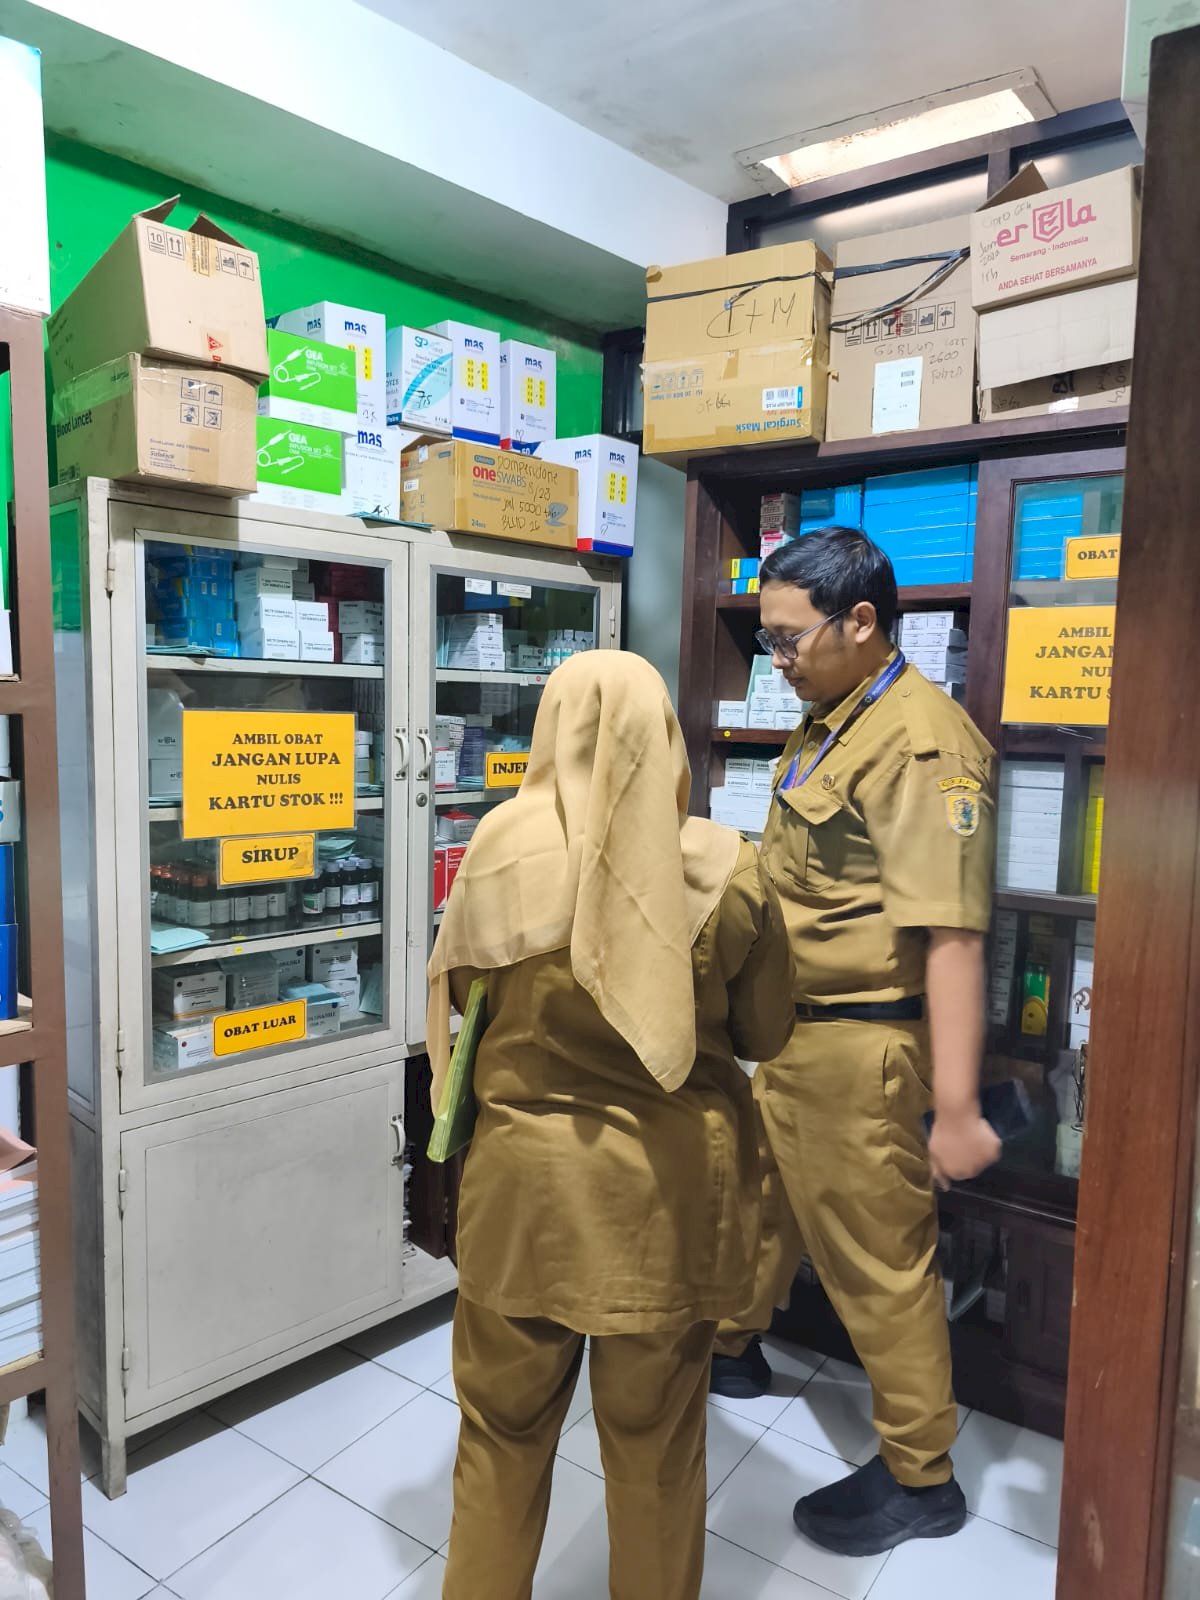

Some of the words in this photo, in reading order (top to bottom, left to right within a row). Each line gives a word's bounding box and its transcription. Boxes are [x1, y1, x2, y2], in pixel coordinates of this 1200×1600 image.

[150, 232, 163, 244] 10
[1009, 247, 1047, 263] Semarang
[1052, 235, 1089, 251] Indonesia
[998, 277, 1019, 292] ANDA
[1020, 272, 1044, 286] SEHAT
[1045, 257, 1098, 279] BERSAMANYA
[307, 318, 322, 332] mas
[344, 320, 367, 335] mas
[464, 337, 484, 351] mas
[524, 356, 543, 370] mas
[72, 409, 93, 431] Lancet
[763, 417, 802, 432] Surgical
[736, 422, 761, 434] Mask
[357, 430, 382, 448] mas
[574, 448, 592, 462] mas
[609, 451, 625, 464] mas
[1077, 549, 1118, 560] OBAT
[1058, 627, 1111, 638] AMBIL
[1030, 686, 1101, 699] KARTU
[232, 733, 280, 745] AMBIL
[284, 733, 323, 745] OBAT
[212, 753, 291, 767] JANGAN
[295, 752, 340, 765] LUPA
[257, 774, 301, 785] NULIS
[209, 794, 275, 810] KARTU
[280, 793, 325, 806] STOK
[329, 792, 343, 804] !!!
[241, 846, 299, 864] SIRUP
[224, 1023, 260, 1038] OBAT
[263, 1015, 297, 1030] LUAR
